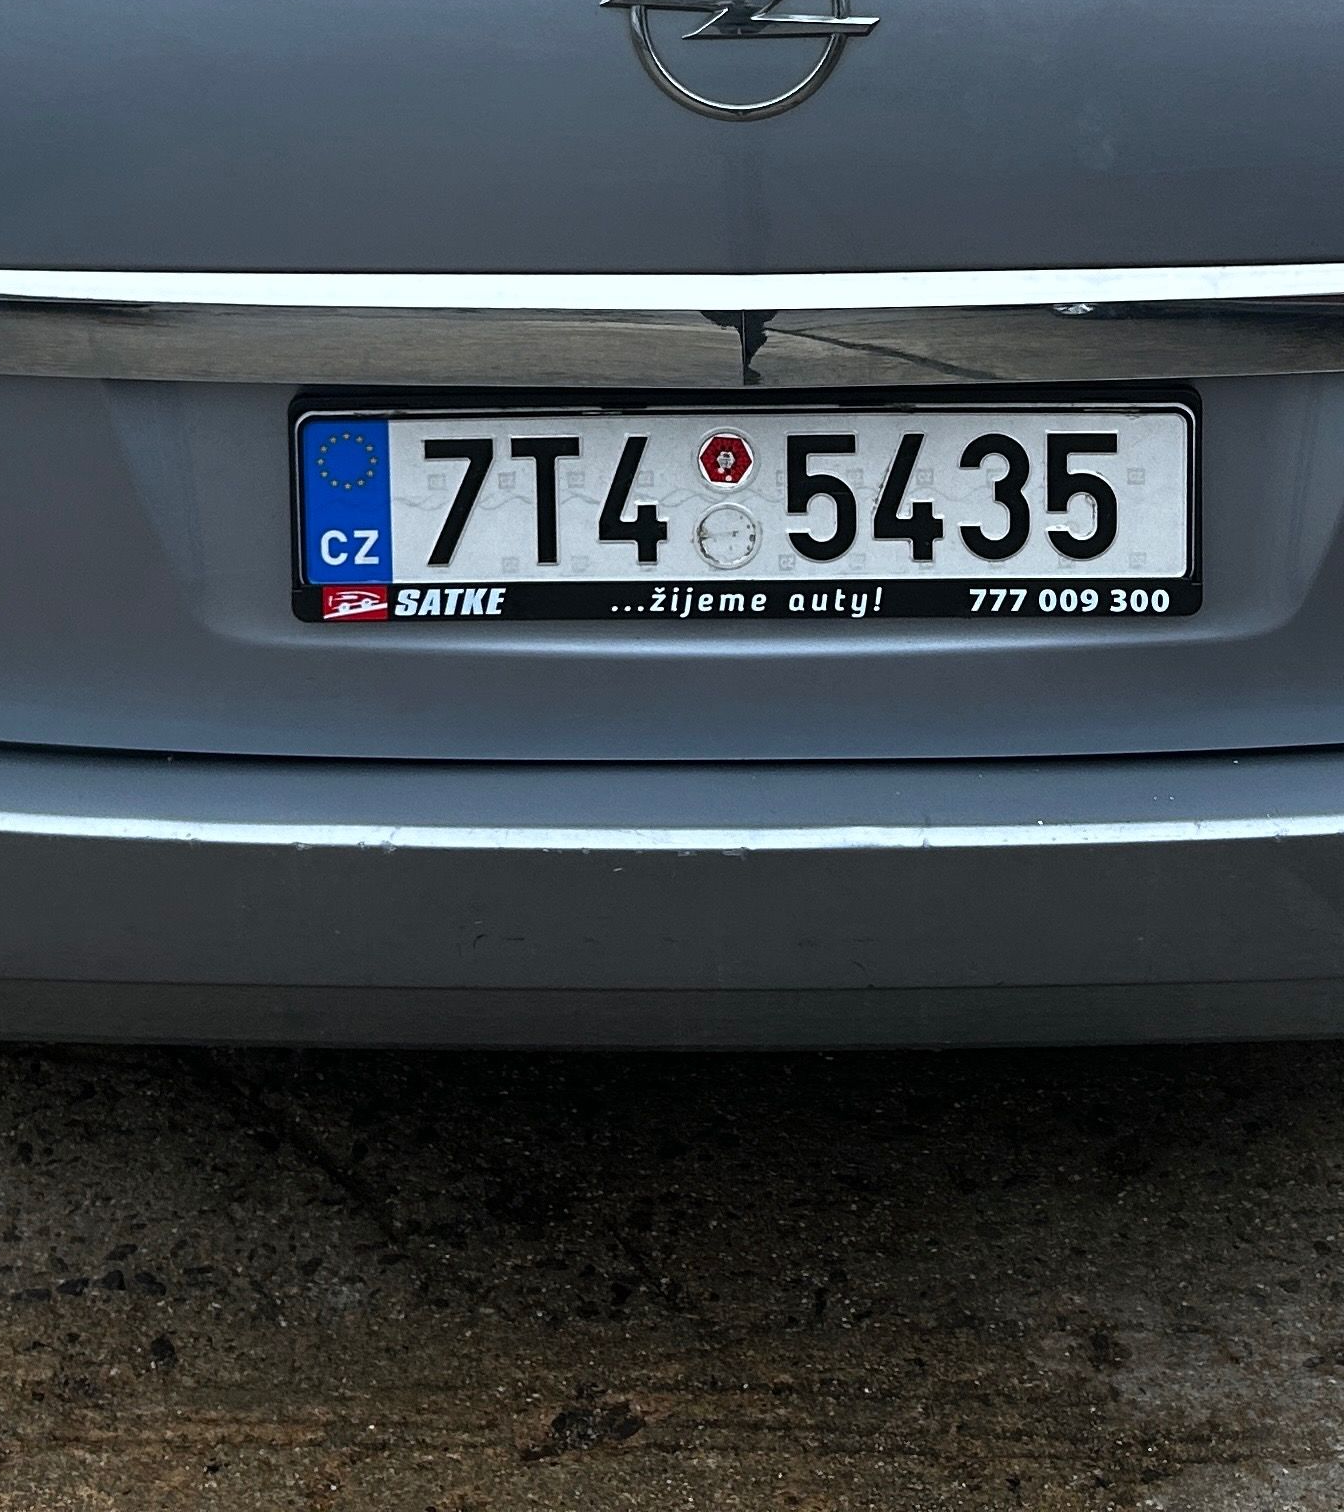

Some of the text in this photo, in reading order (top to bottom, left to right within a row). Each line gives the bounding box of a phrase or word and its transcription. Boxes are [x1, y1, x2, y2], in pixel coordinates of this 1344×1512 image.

[423, 433, 1118, 567] 7T4 5435
[320, 529, 380, 565] CZ
[394, 587, 1170, 618] SATKE ...žijeme auty! 777 009 300
